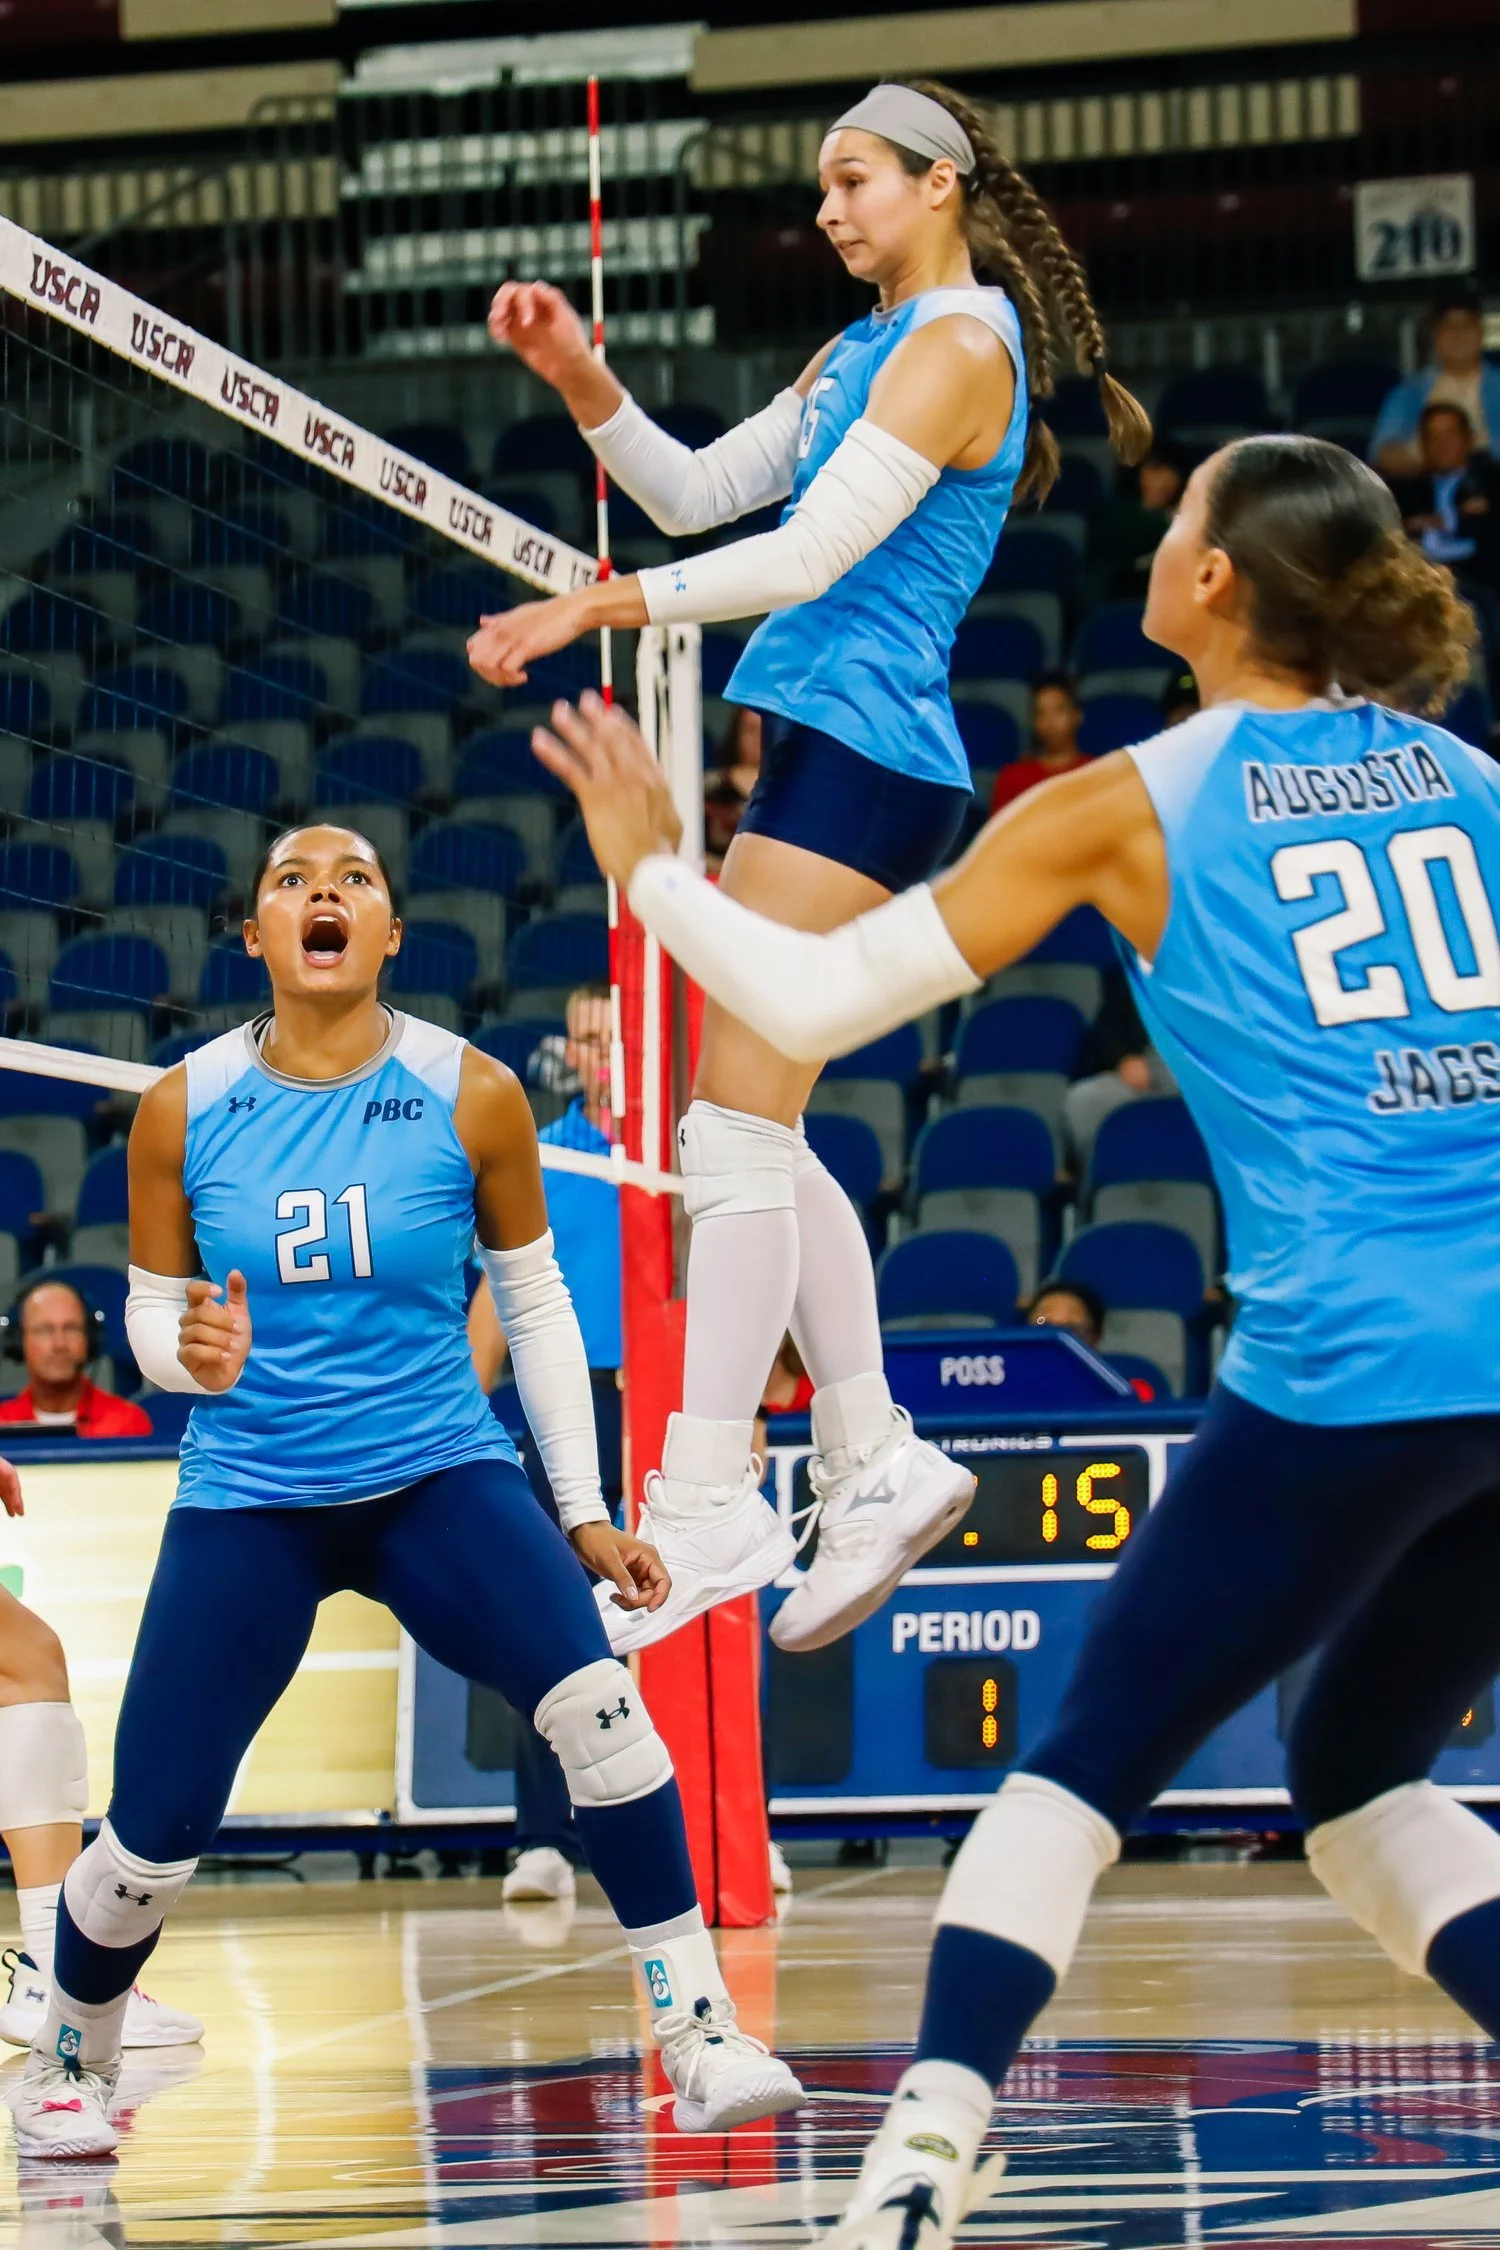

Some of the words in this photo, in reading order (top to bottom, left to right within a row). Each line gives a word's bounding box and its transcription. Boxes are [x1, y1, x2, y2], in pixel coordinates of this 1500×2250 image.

[1244, 741, 1455, 823] AUGUSTA
[1269, 824, 1500, 1029] 20
[362, 1097, 424, 1125] PBC
[1367, 1040, 1500, 1114] JAGS
[274, 1182, 375, 1286] 21
[938, 1355, 1006, 1387] POSS
[1040, 1461, 1132, 1551] 15
[891, 1609, 1041, 1654] PERIOD
[981, 1678, 998, 1749] 1
